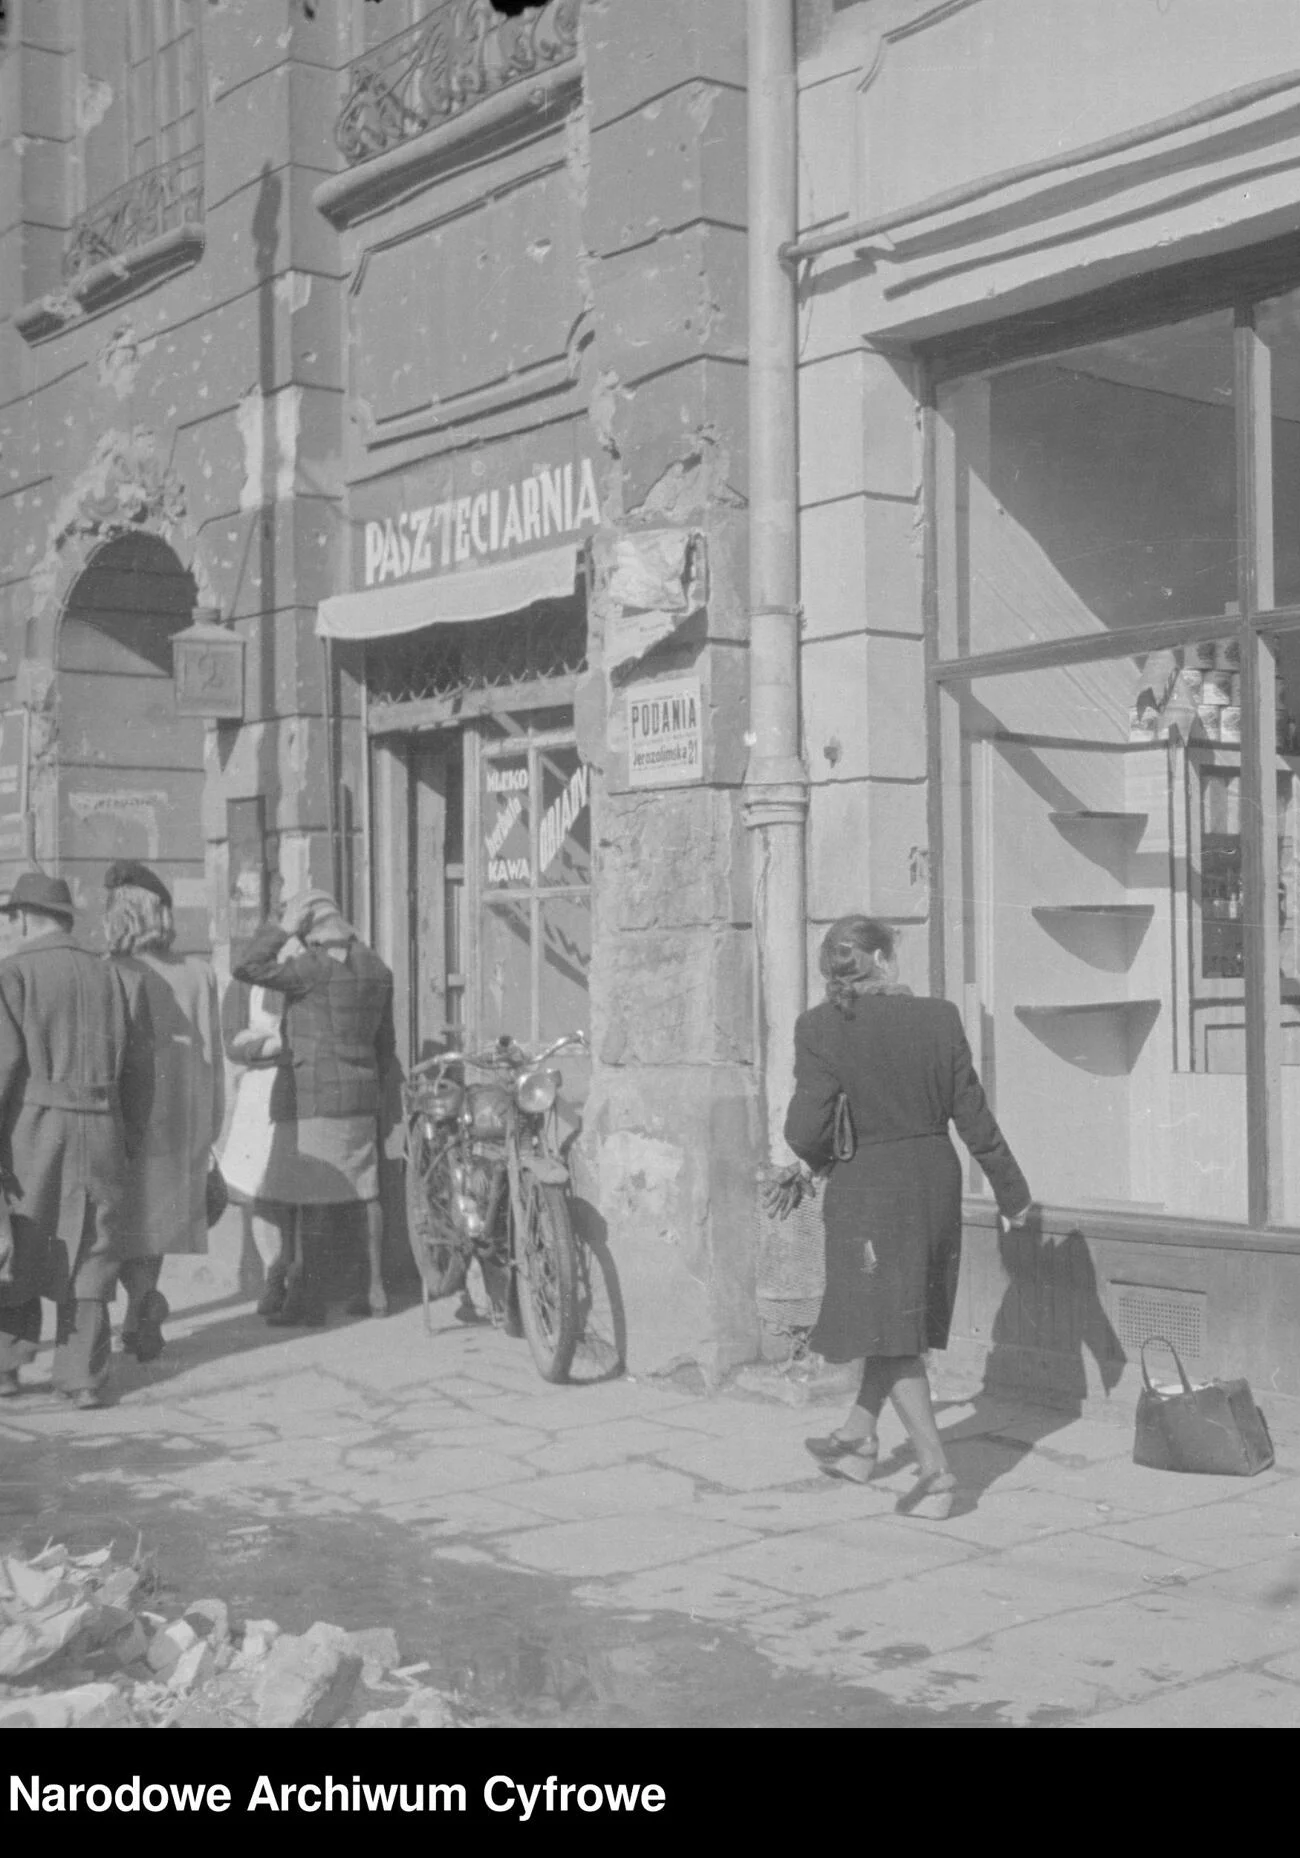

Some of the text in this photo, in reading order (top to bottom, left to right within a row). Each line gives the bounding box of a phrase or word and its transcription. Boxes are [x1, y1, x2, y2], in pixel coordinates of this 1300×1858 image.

[364, 457, 600, 586] PASZTECIARNIA
[632, 698, 697, 739] PODANIA
[488, 858, 530, 883] KAWA
